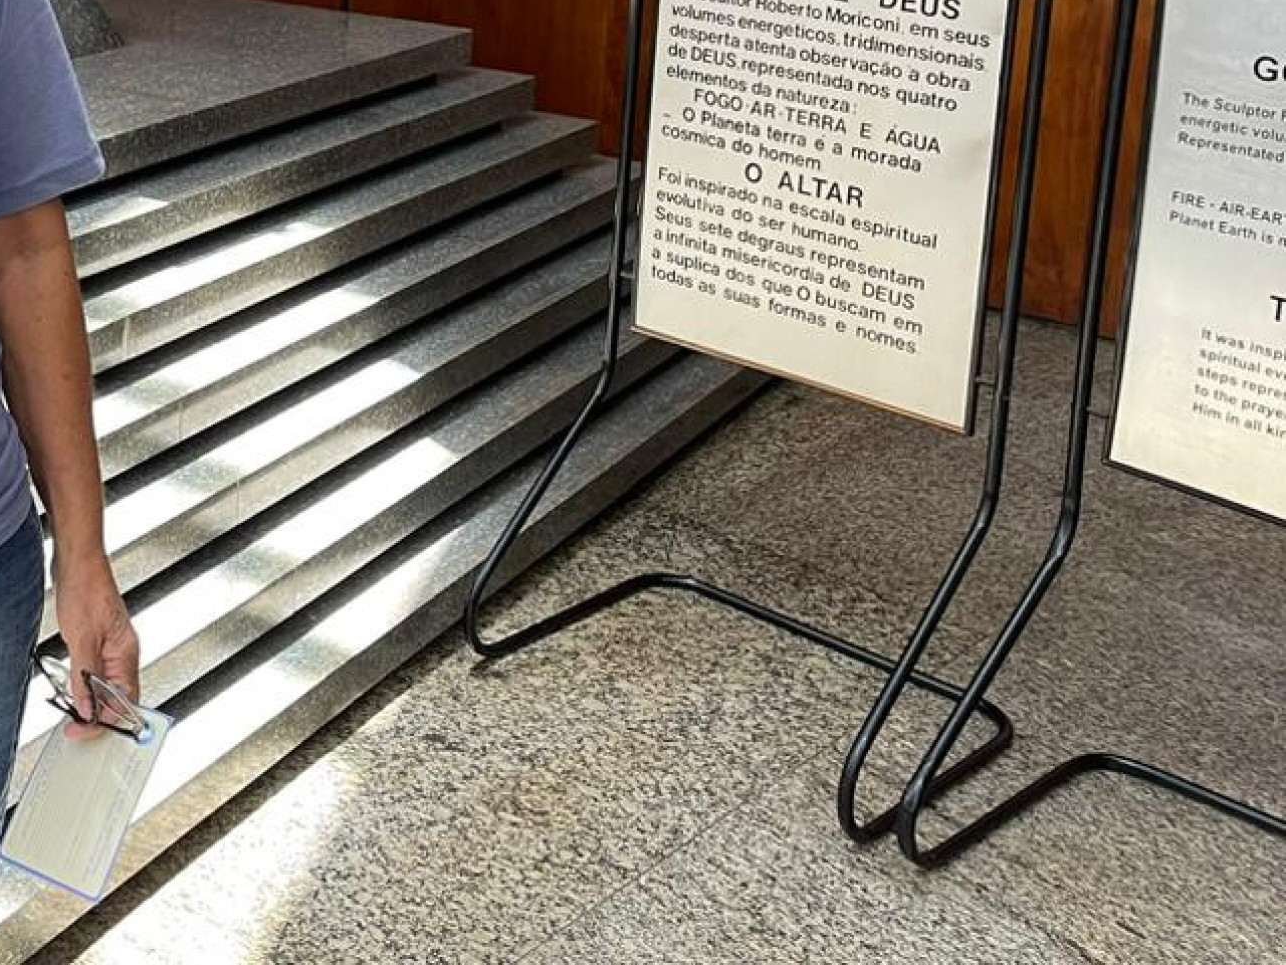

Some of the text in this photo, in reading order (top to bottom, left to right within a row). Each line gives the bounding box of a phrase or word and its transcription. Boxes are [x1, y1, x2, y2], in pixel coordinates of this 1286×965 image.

[671, 3, 735, 28] volumes
[909, 22, 939, 39] em
[943, 28, 991, 48] seus
[668, 23, 741, 49] desperta
[744, 38, 797, 60] atenta
[799, 48, 903, 79] observação
[925, 71, 971, 92] obra
[666, 64, 747, 93] elementos
[751, 81, 772, 98] da
[668, 42, 688, 60] de
[741, 59, 853, 92] representada
[857, 81, 891, 99] nos
[895, 87, 958, 112] quatro
[1182, 92, 1211, 107] The
[1213, 97, 1277, 119] Sculptor
[682, 106, 696, 122] O
[700, 109, 761, 137] Planeta
[767, 125, 807, 147] terra
[832, 142, 843, 156] a
[850, 145, 922, 173] morada
[859, 122, 872, 140] E
[885, 124, 941, 154] ÁGUA
[1179, 115, 1249, 136] energetic
[732, 139, 753, 155] do
[744, 161, 863, 208] O ALTAR
[656, 189, 725, 217] evolutiva
[731, 208, 753, 223] do
[758, 215, 785, 231] ser
[658, 166, 938, 250] Foi inspirado na escala espiritual
[1170, 190, 1206, 209] FIRE
[1219, 200, 1286, 226] AIR-EAR
[1169, 209, 1215, 231] Planet
[1218, 221, 1257, 240] Earth
[1261, 231, 1273, 245] is
[655, 204, 926, 291] Seus sete degraus representam
[665, 228, 717, 256] infinita
[829, 274, 851, 293] de
[861, 281, 915, 311] DEUS
[651, 264, 917, 354] todas as suas formas e nomes
[725, 267, 755, 286] dos
[761, 278, 793, 297] que
[797, 285, 811, 301] O
[815, 289, 887, 323] buscam
[893, 316, 923, 335] em
[1215, 332, 1245, 349] was
[1198, 367, 1238, 387] steps
[1199, 349, 1261, 373] spiritual
[1194, 383, 1209, 397] to
[1214, 389, 1237, 405] the
[1192, 401, 1222, 419] Him
[1225, 411, 1240, 427] in
[1243, 419, 1263, 433] all
